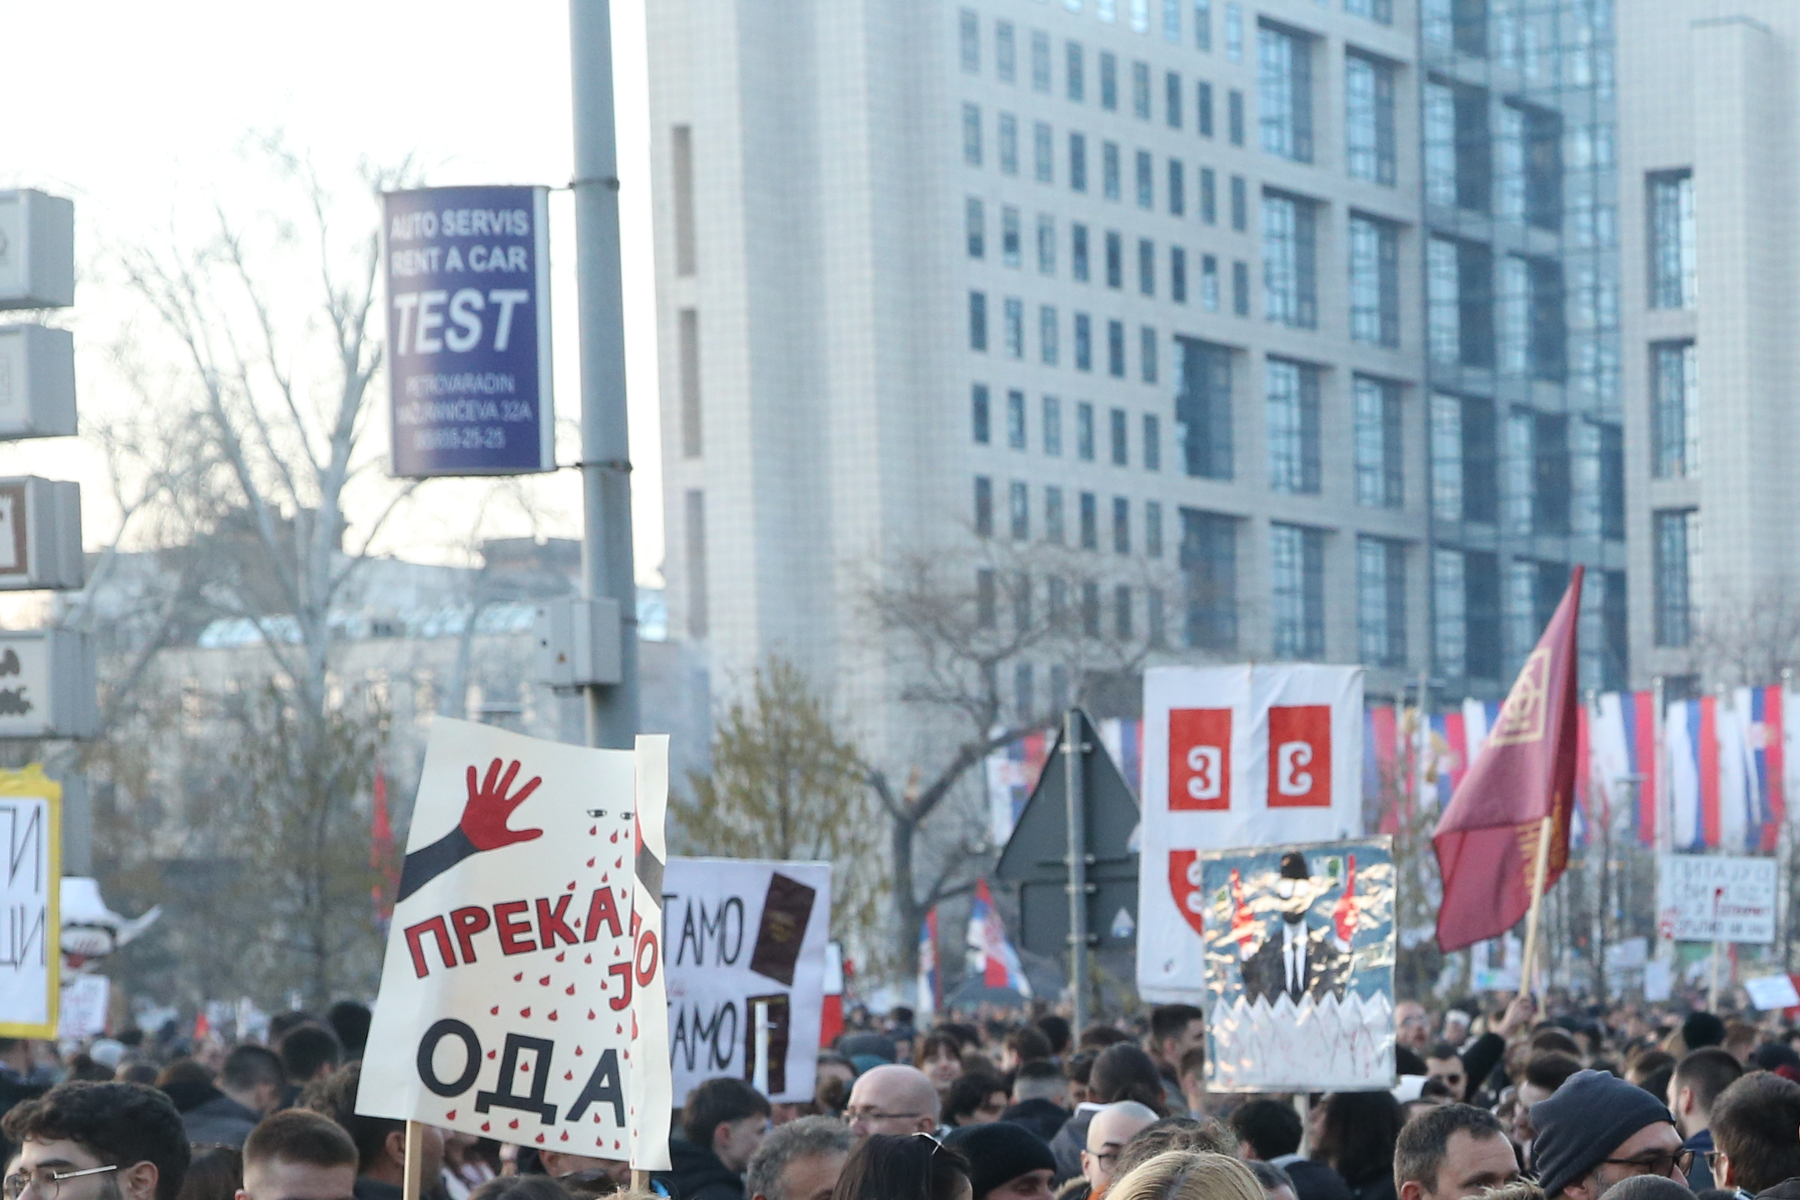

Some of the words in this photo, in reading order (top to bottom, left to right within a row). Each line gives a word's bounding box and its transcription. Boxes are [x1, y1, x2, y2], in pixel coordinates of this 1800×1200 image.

[390, 211, 438, 240] AUTO
[442, 209, 530, 237] SERVIS
[391, 248, 441, 276] RENT
[445, 246, 464, 272] A
[468, 245, 529, 272] CAR
[394, 288, 530, 356] TEST
